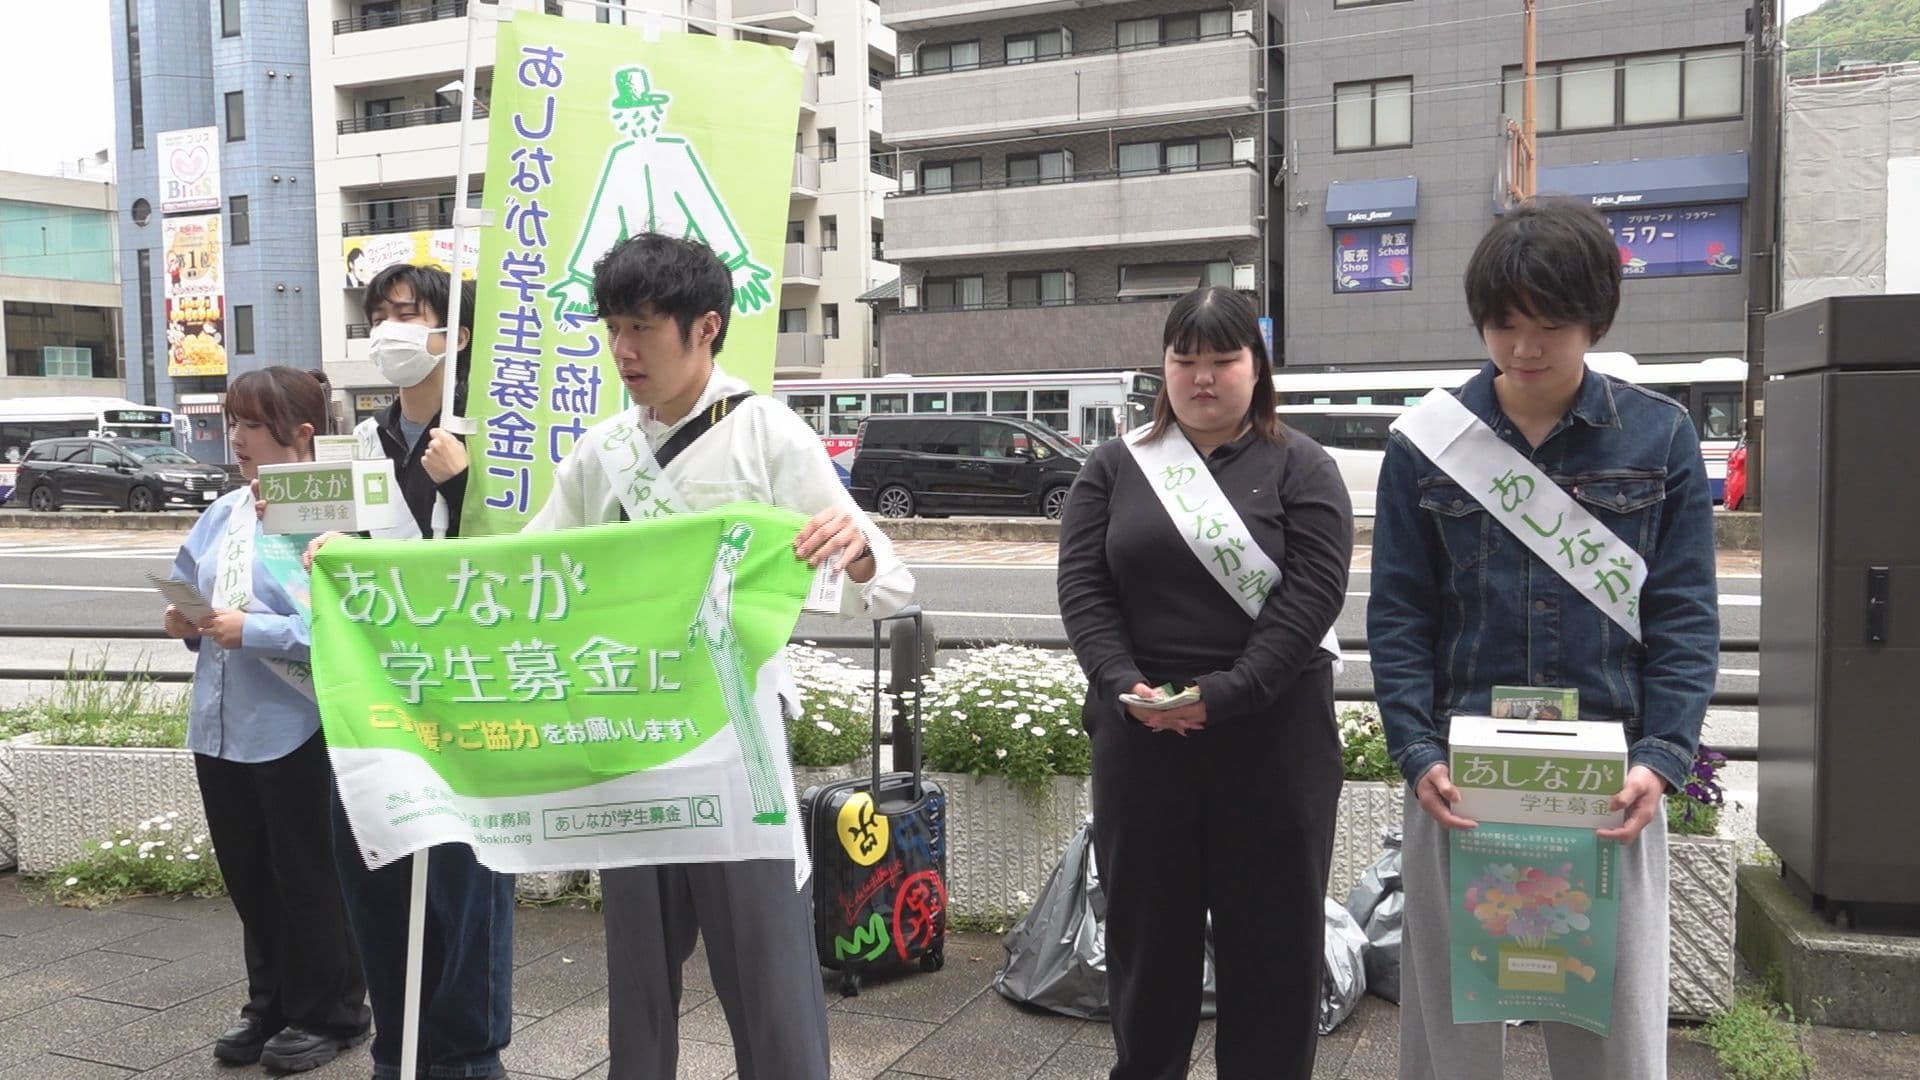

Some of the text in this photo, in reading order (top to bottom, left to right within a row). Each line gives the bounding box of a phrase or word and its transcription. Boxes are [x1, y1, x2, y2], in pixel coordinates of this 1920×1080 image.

[1377, 246, 1410, 257] School
[1381, 232, 1408, 247] 教室
[1342, 263, 1369, 273] Shop
[1343, 249, 1369, 263] 販売
[838, 440, 854, 448] BUS
[265, 473, 348, 502] あしなが
[298, 503, 350, 521] 学生募金
[1160, 462, 1274, 604] あしなが学
[224, 496, 251, 612] しなが学
[334, 552, 588, 628] あしなが
[379, 636, 683, 705] 学生募金に
[1462, 756, 1615, 791] あしなが
[1520, 793, 1612, 816] 学生募金
[555, 804, 682, 832] あしなが学生募金
